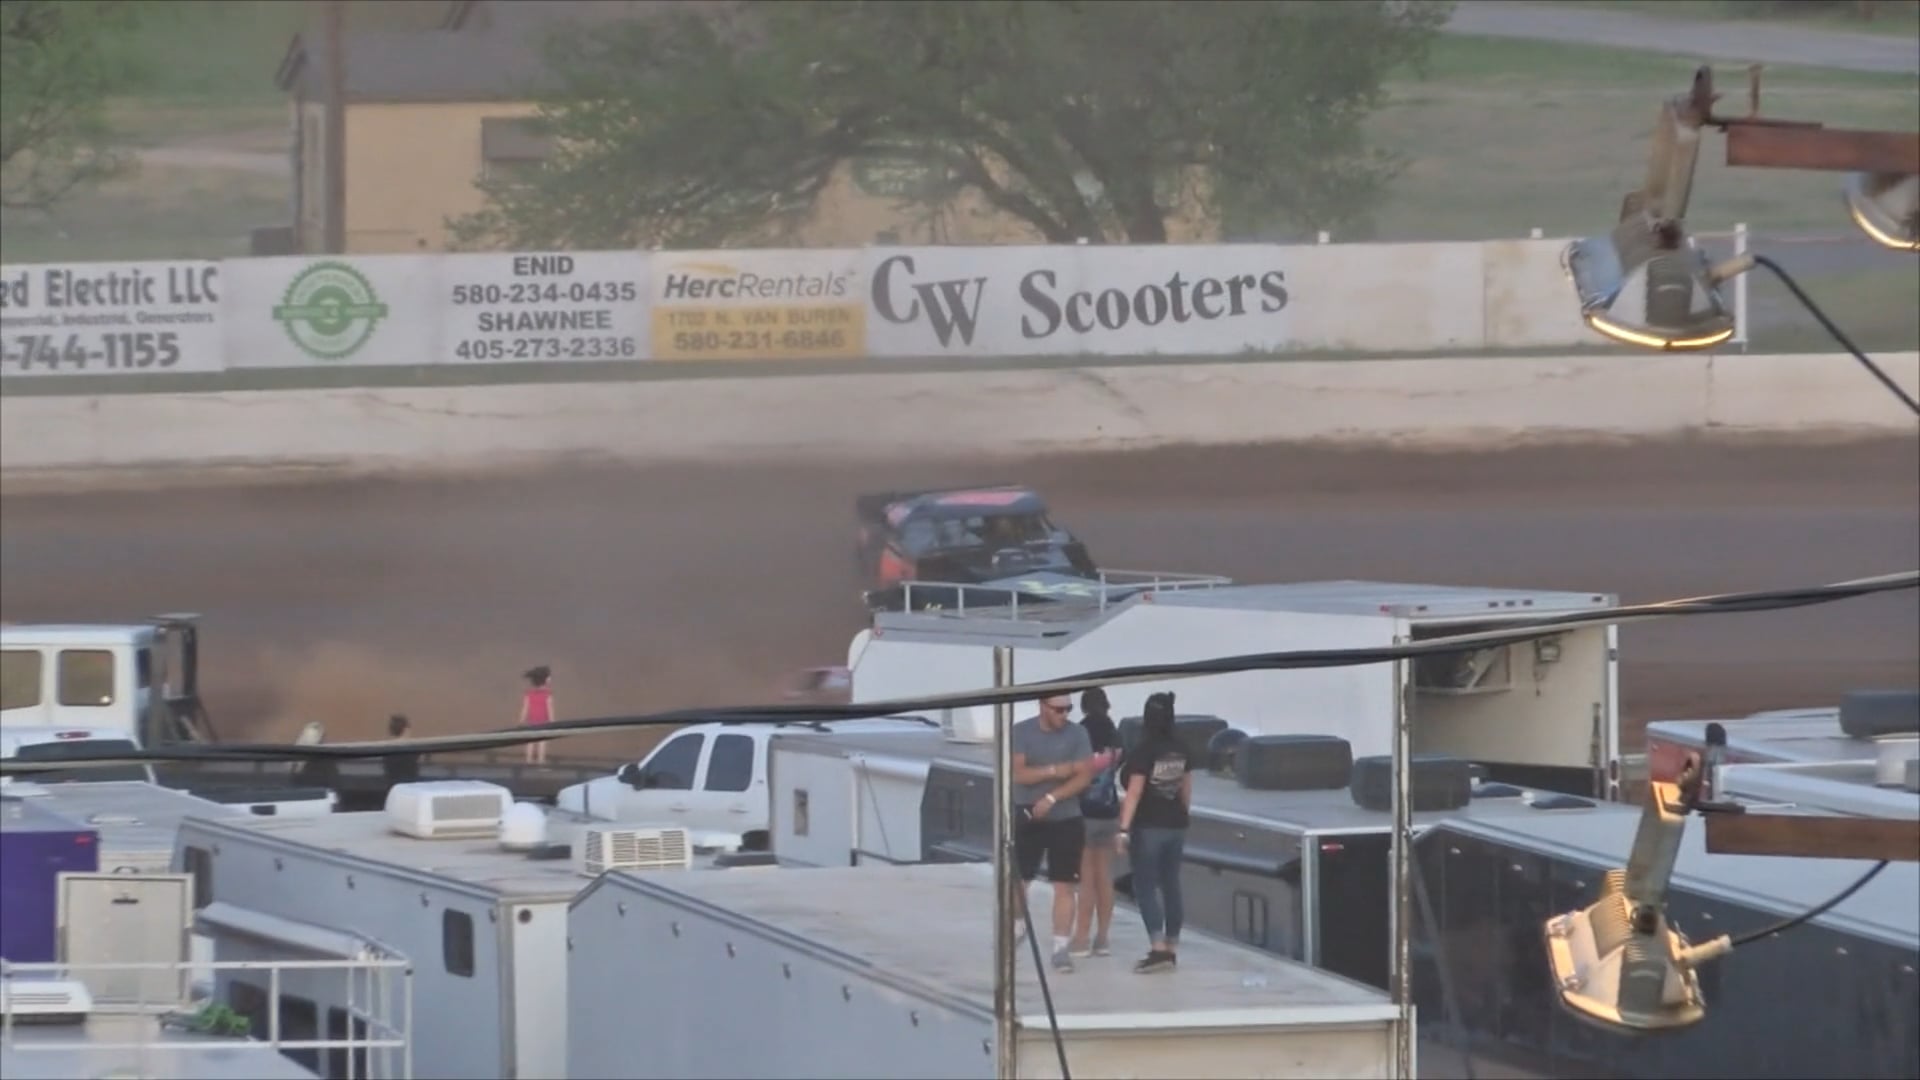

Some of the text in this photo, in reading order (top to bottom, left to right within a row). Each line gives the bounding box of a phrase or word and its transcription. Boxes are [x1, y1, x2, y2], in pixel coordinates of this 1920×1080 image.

[513, 256, 574, 275] ENID
[45, 269, 155, 307] Electric
[169, 266, 219, 303] LLC
[453, 282, 636, 304] 580-234-0435
[664, 272, 847, 298] HercRentals
[1019, 269, 1289, 340] Scooters
[478, 310, 613, 332] SHAWNEE
[1, 332, 180, 370] -744-1155
[455, 338, 636, 359] 405-273-2336
